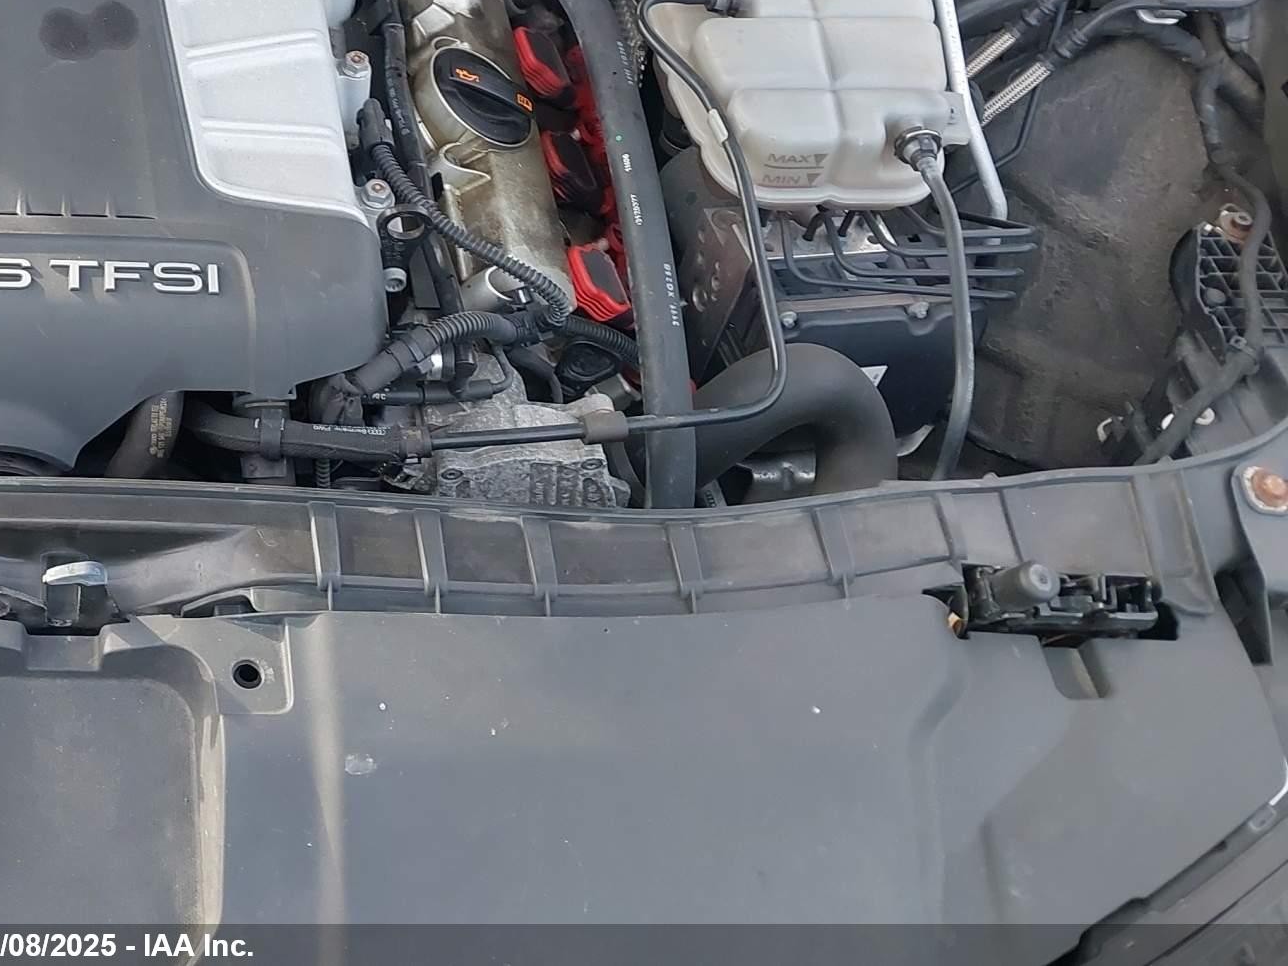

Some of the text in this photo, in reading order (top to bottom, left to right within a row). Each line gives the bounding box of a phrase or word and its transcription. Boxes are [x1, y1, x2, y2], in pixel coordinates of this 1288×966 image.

[768, 153, 811, 164] MAX
[762, 174, 801, 185] MIN
[48, 258, 220, 294] TFSI
